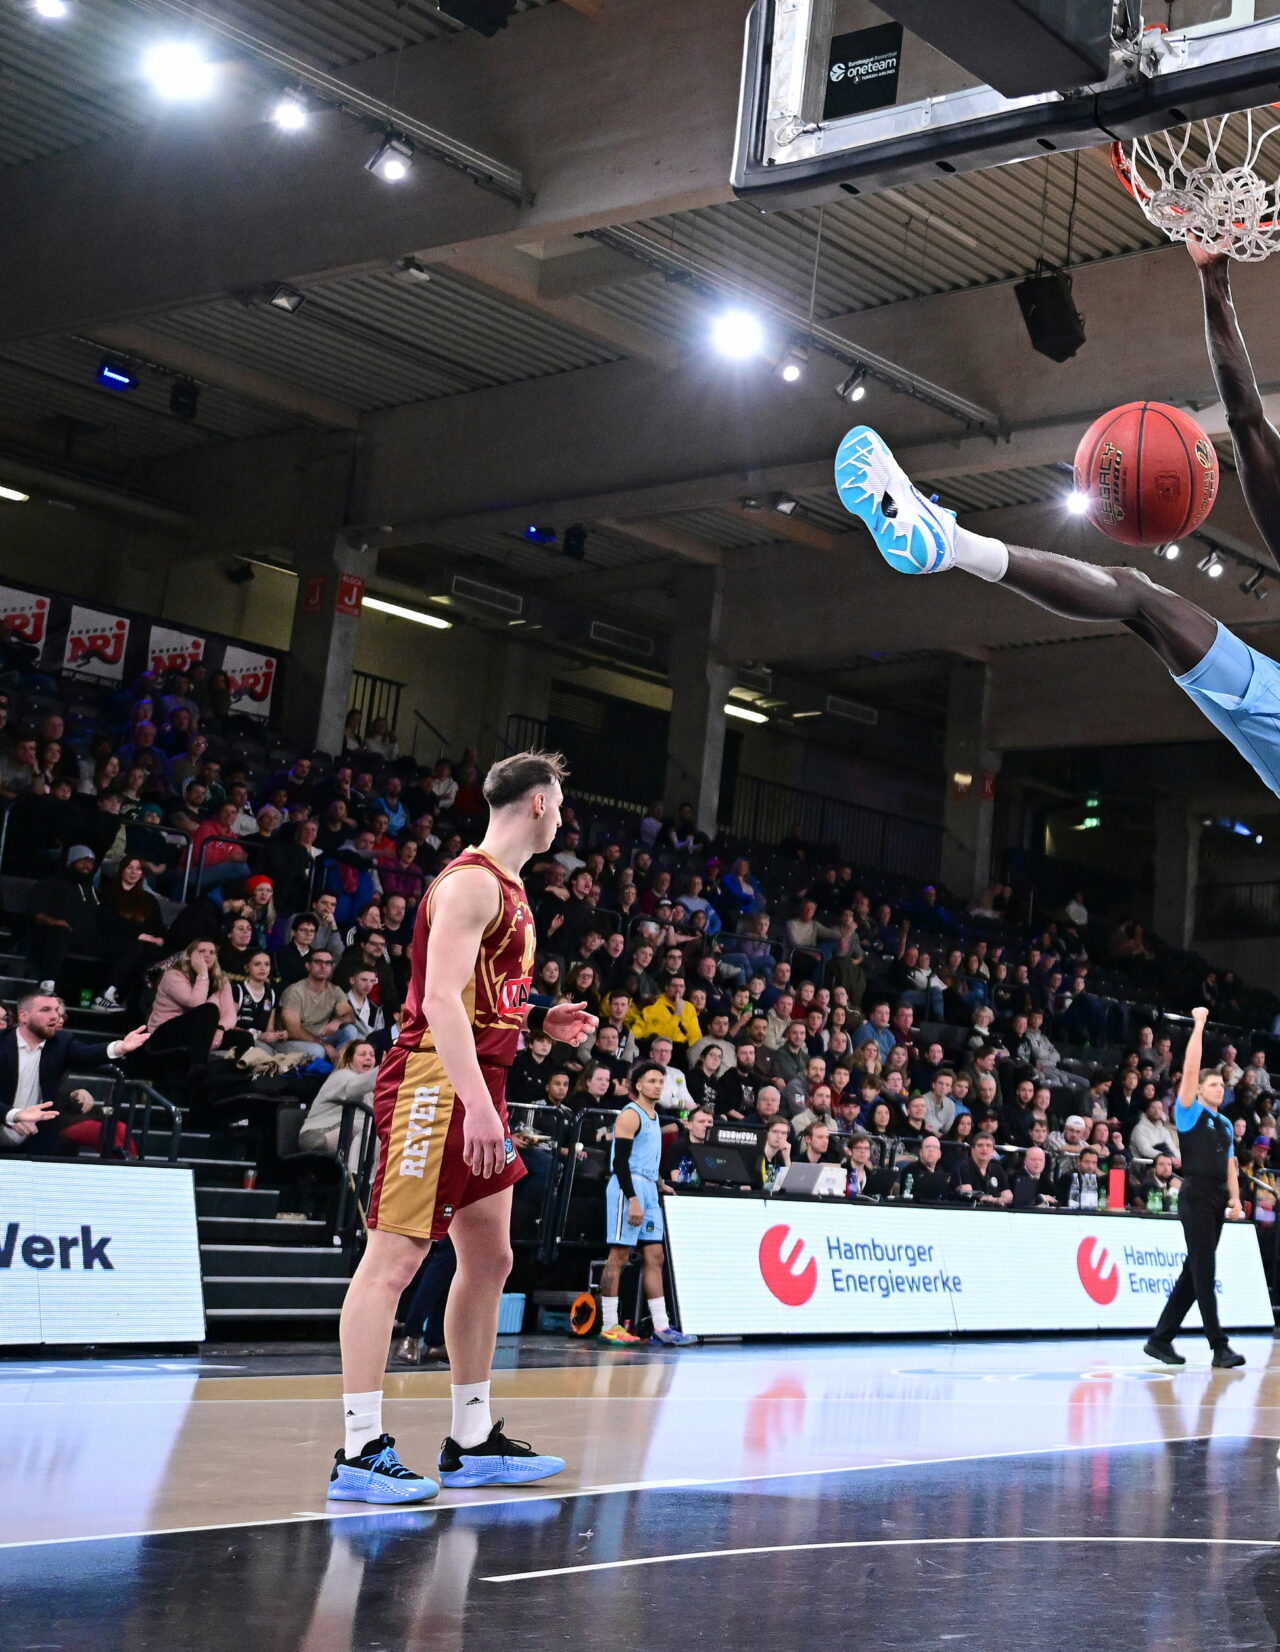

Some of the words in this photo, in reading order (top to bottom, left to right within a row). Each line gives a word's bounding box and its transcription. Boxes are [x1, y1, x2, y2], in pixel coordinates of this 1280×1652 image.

[847, 58, 897, 78] oneteam
[1099, 442, 1117, 526] LEGACY
[344, 586, 358, 606] J
[67, 620, 127, 665] NRJ
[399, 1085, 441, 1179] REYER
[826, 1236, 934, 1267] Hamburger
[831, 1268, 962, 1298] Energiewerke
